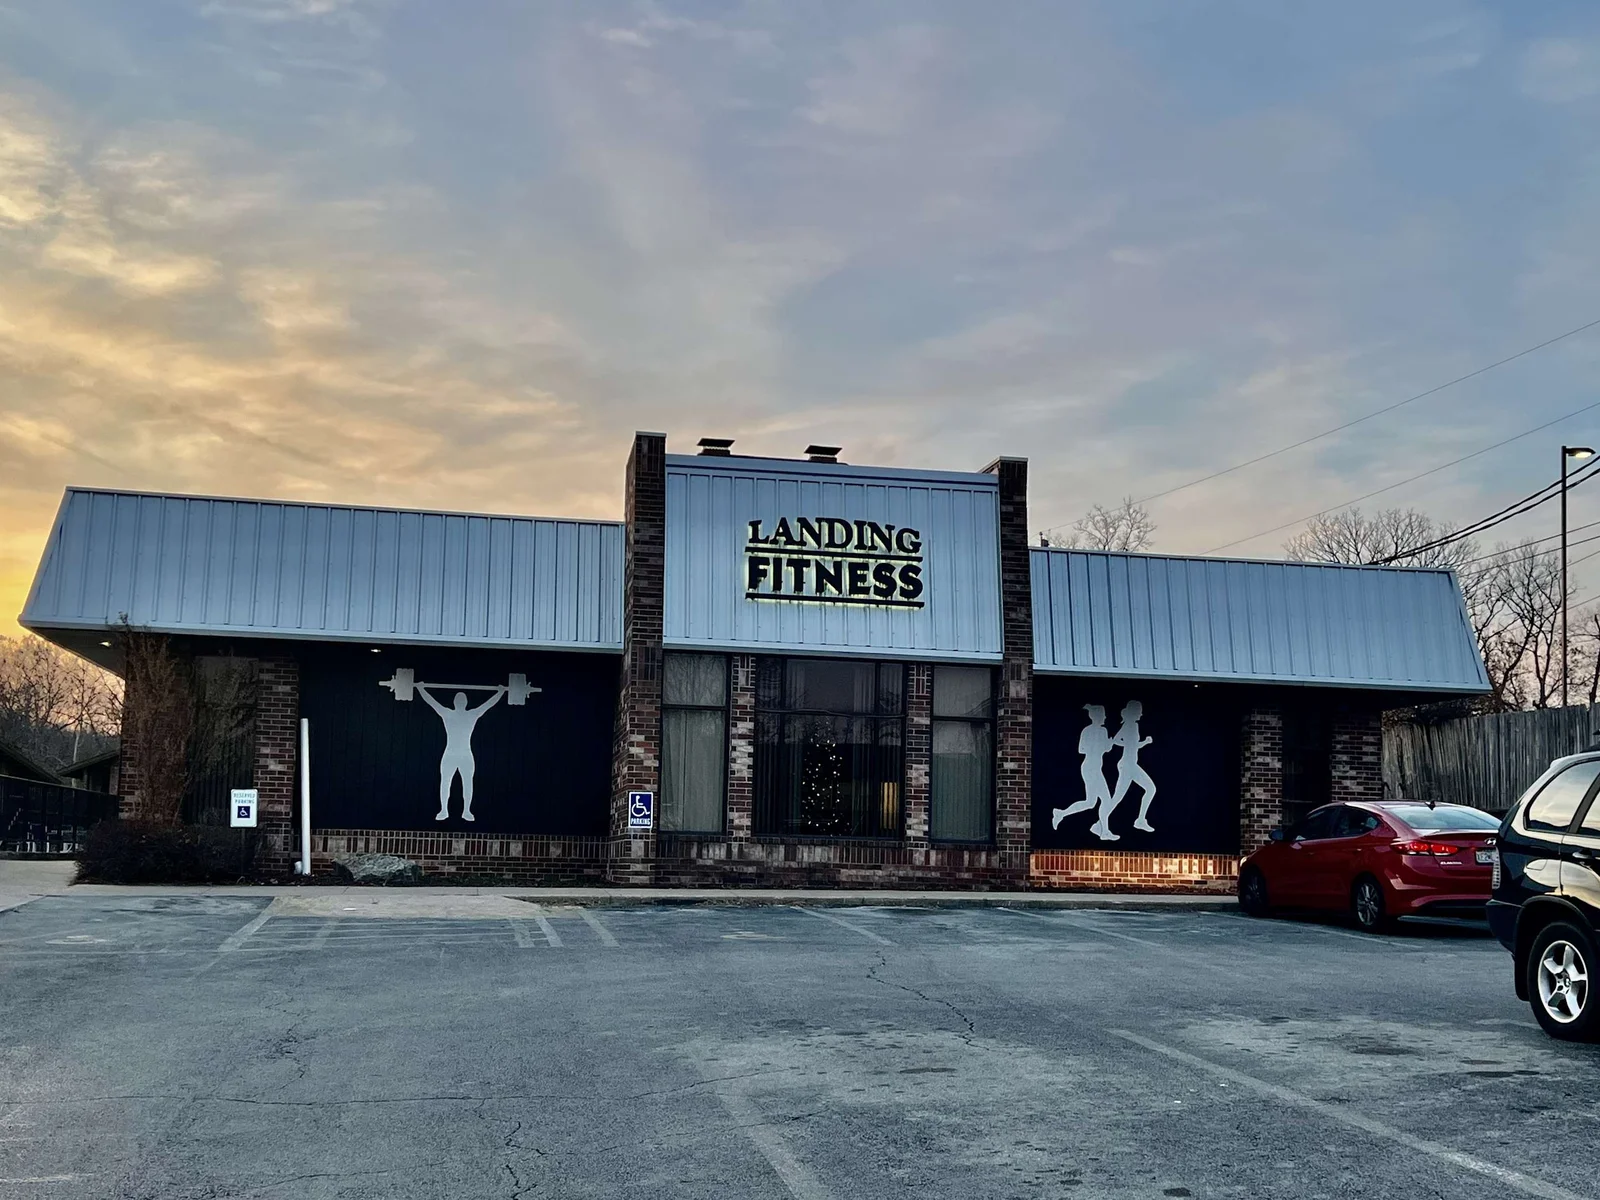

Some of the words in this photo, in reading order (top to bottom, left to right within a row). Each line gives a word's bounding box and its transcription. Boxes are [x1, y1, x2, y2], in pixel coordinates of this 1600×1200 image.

[748, 517, 922, 553] LANDING
[747, 555, 923, 599] FITNESS
[630, 817, 651, 825] PARKING
